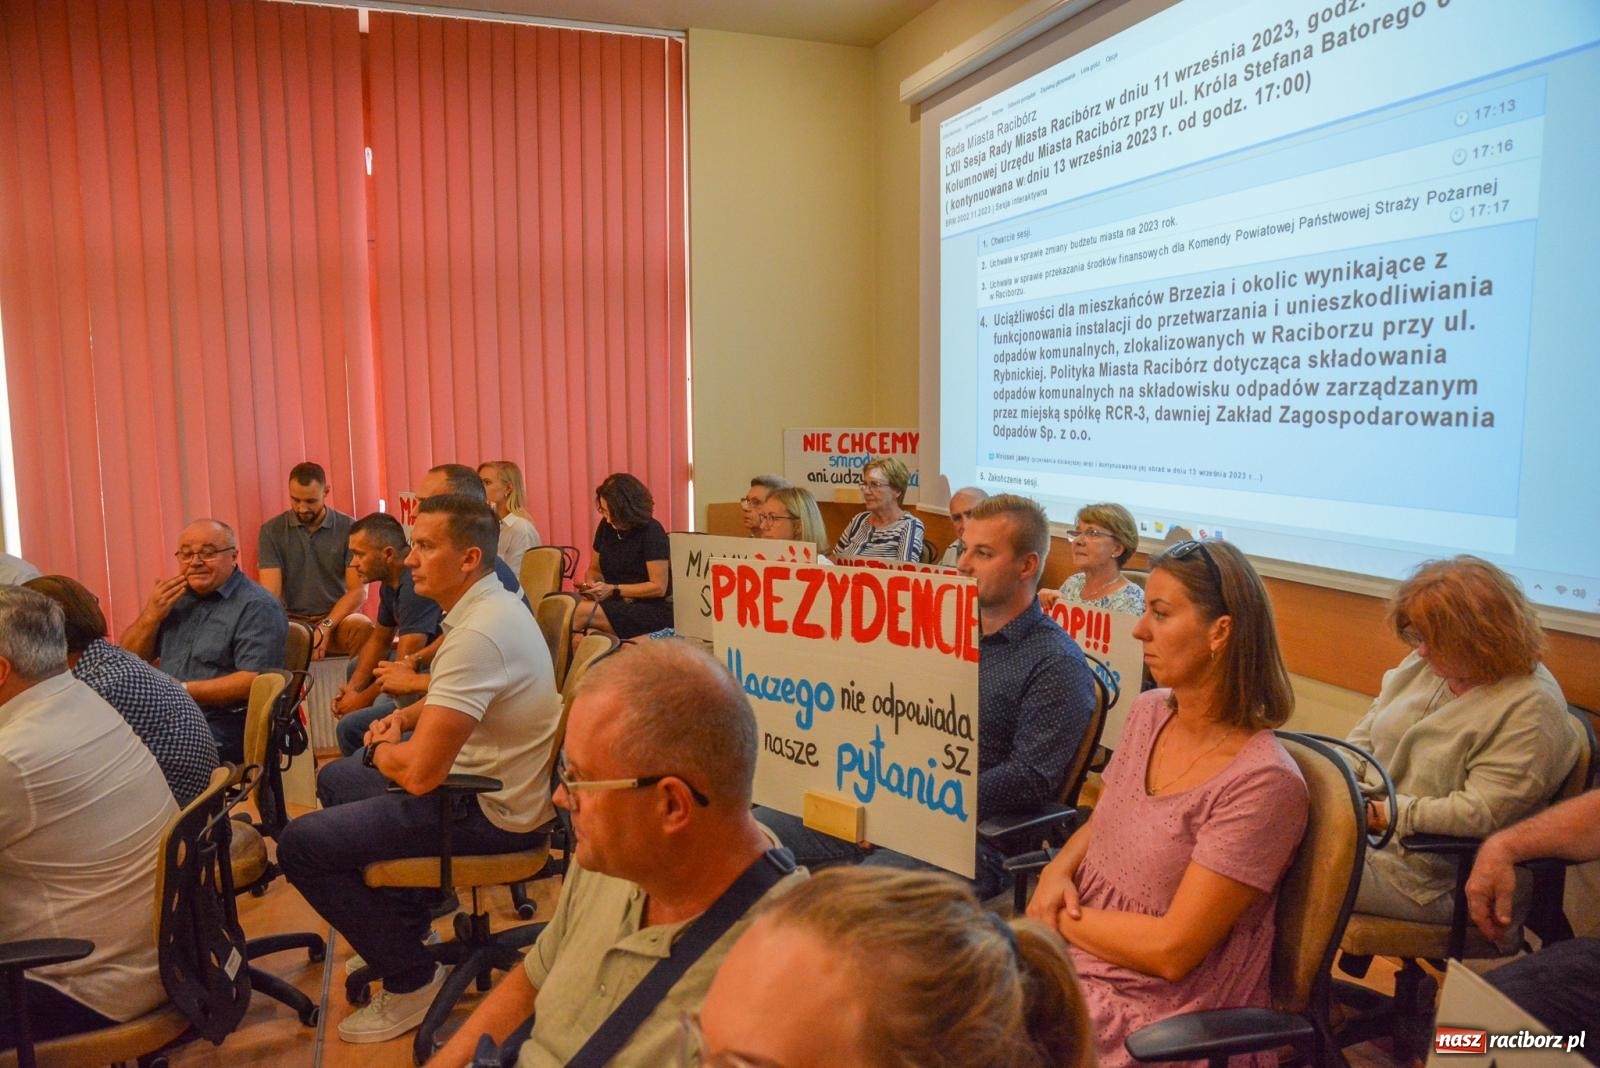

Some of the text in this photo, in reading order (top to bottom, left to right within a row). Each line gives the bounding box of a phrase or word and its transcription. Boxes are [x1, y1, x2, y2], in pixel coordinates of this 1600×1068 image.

[945, 160, 960, 176] LXII
[963, 151, 986, 169] Sesja
[989, 140, 1012, 159] Rady
[1015, 126, 1047, 149] Miasta
[1050, 103, 1101, 133] Racibórz
[1105, 96, 1116, 111] w
[1120, 83, 1149, 105] dniu
[1154, 71, 1168, 91] 11
[1174, 43, 1246, 83] września
[1251, 18, 1299, 51] 2023,
[945, 1, 1426, 194] Kolumnowej Urzędu Miasta Racibórz przy ul. Króla Stefana Batorego
[1474, 98, 1517, 121] 17:13
[945, 143, 965, 159] Rada
[967, 129, 994, 150] Miasta
[997, 110, 1037, 137] Racibórz
[950, 180, 1013, 211] kontynuowana
[1015, 176, 1026, 188] w
[1027, 166, 1050, 183] dniu
[1053, 158, 1066, 175] 13
[1069, 140, 1122, 170] września
[1126, 126, 1157, 151] 2023
[1162, 125, 1172, 138] r.
[1178, 110, 1196, 131] od
[1202, 98, 1247, 128] godz.
[1255, 70, 1311, 105] 17:00)
[1472, 138, 1514, 160] 17:16
[995, 200, 1011, 211] Sesja
[1470, 199, 1511, 218] 17:17
[1013, 254, 1019, 262] w
[1020, 249, 1043, 264] sprawie
[1045, 242, 1068, 256] zmiany
[1099, 229, 1124, 243] miasta
[1126, 226, 1136, 237] na
[1138, 220, 1159, 235] 2023
[1162, 216, 1178, 229] rok.
[1020, 271, 1043, 285] sprawie
[1044, 263, 1085, 280] przekazania
[1086, 255, 1117, 271] środków
[1118, 245, 1169, 264] finansowych
[1172, 242, 1185, 254] dla
[1188, 233, 1231, 251] Komendy
[1235, 218, 1295, 242] Powiatowej
[1299, 203, 1370, 230] Państwowej
[1374, 196, 1420, 215] Straży
[1426, 177, 1498, 206] Pożarnej
[979, 251, 1448, 328] 4. Uciążliwości dla mieszkańców Brzezia i okolic wynikające z
[993, 275, 1493, 345] funkcjonowania instalacji do przetwarzania i unieszkodliwiania
[993, 308, 1476, 365] odpadów komunalnych, zlokalizowanych w Raciborzu przy ul.
[993, 343, 1447, 385] Rybnickiej. Polityka Miasta Racibórz dotycząca składowania
[993, 376, 1479, 403] odpadów komunalnych na składowisku odpadów zarządzanym
[992, 404, 1495, 430] przez miejską spółkę RCR-3, dawniej Zakład Zagospodarowania
[992, 424, 1091, 442] Odpadów Sp. z o.o.
[802, 431, 920, 455] NIE CHCEMY
[828, 451, 875, 469] smrod
[807, 468, 829, 484] ani
[987, 472, 1022, 486] Zakończenie
[1229, 471, 1246, 480] 2023
[711, 564, 979, 663] PREZYDENCIE
[841, 680, 866, 714] nie
[872, 681, 975, 742] odpowiada
[764, 723, 968, 823] nasze pytania
[942, 743, 971, 776] sz
